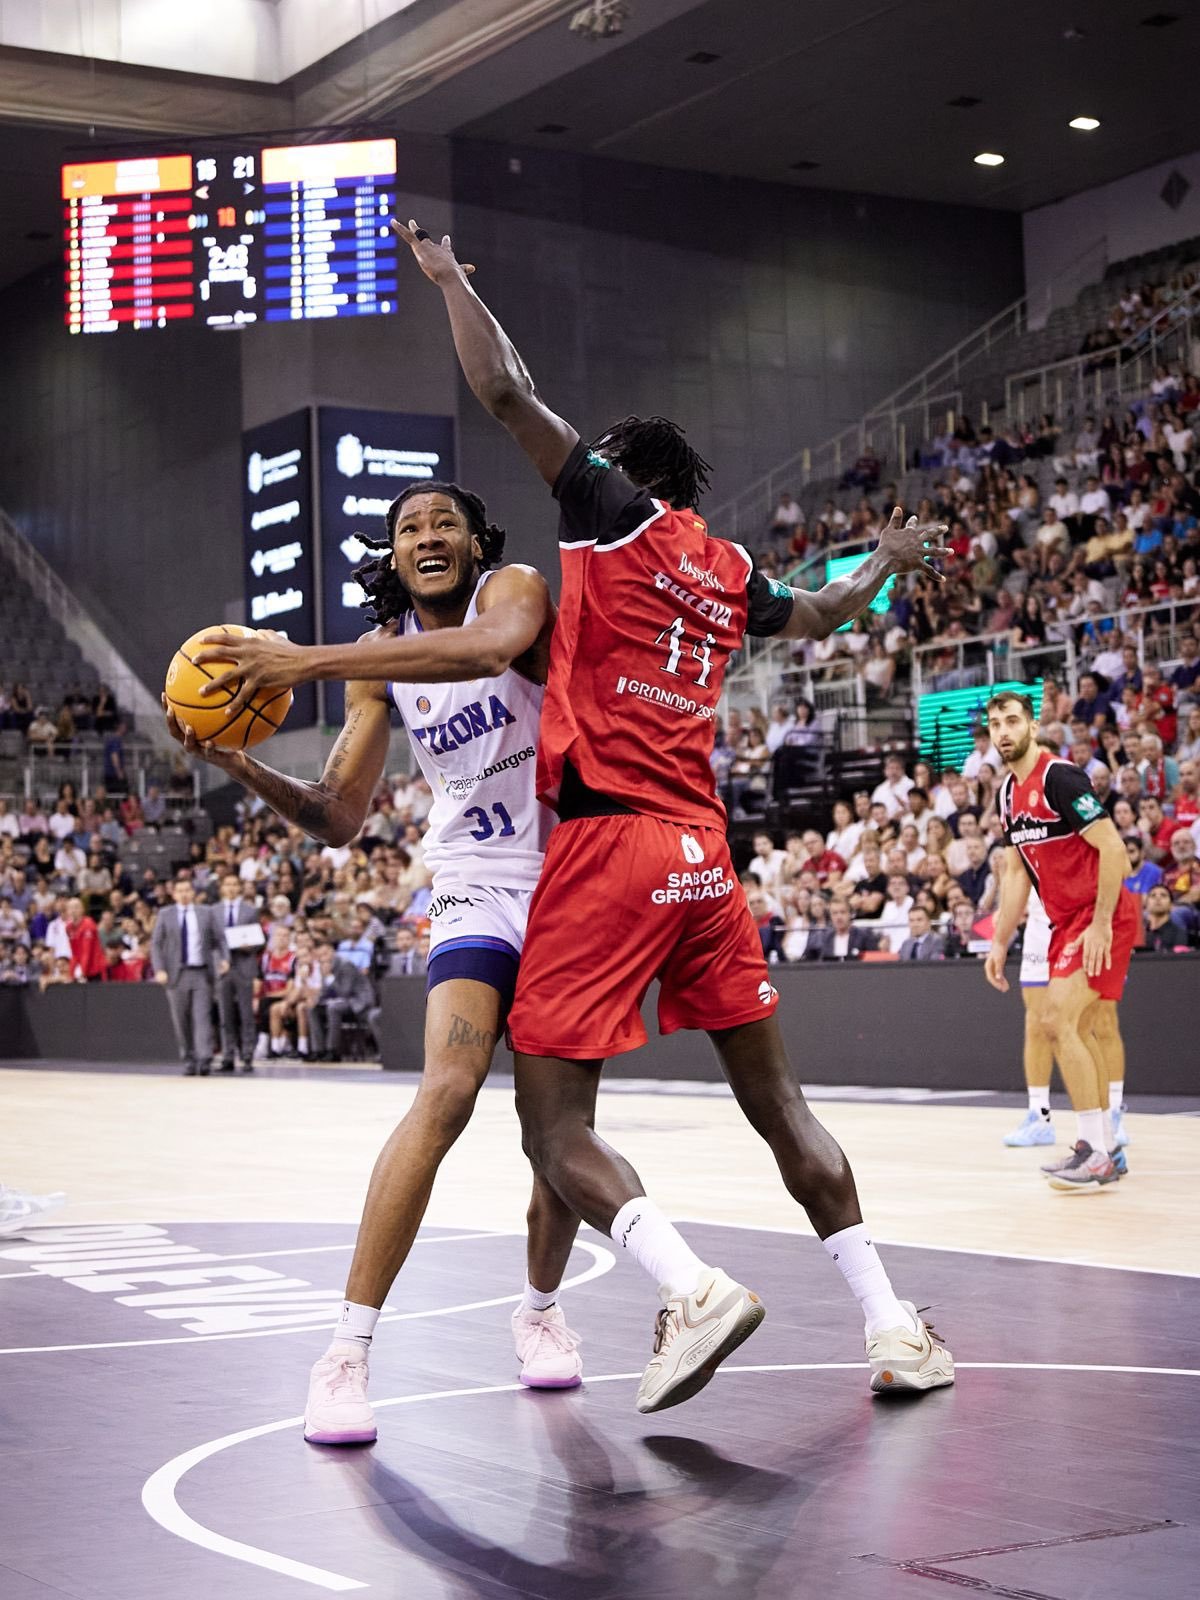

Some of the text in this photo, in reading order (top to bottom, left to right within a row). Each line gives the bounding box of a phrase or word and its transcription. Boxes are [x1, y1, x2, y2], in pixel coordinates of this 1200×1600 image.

[233, 156, 255, 178] 21
[463, 801, 516, 841] 31
[667, 866, 723, 888] SABOR
